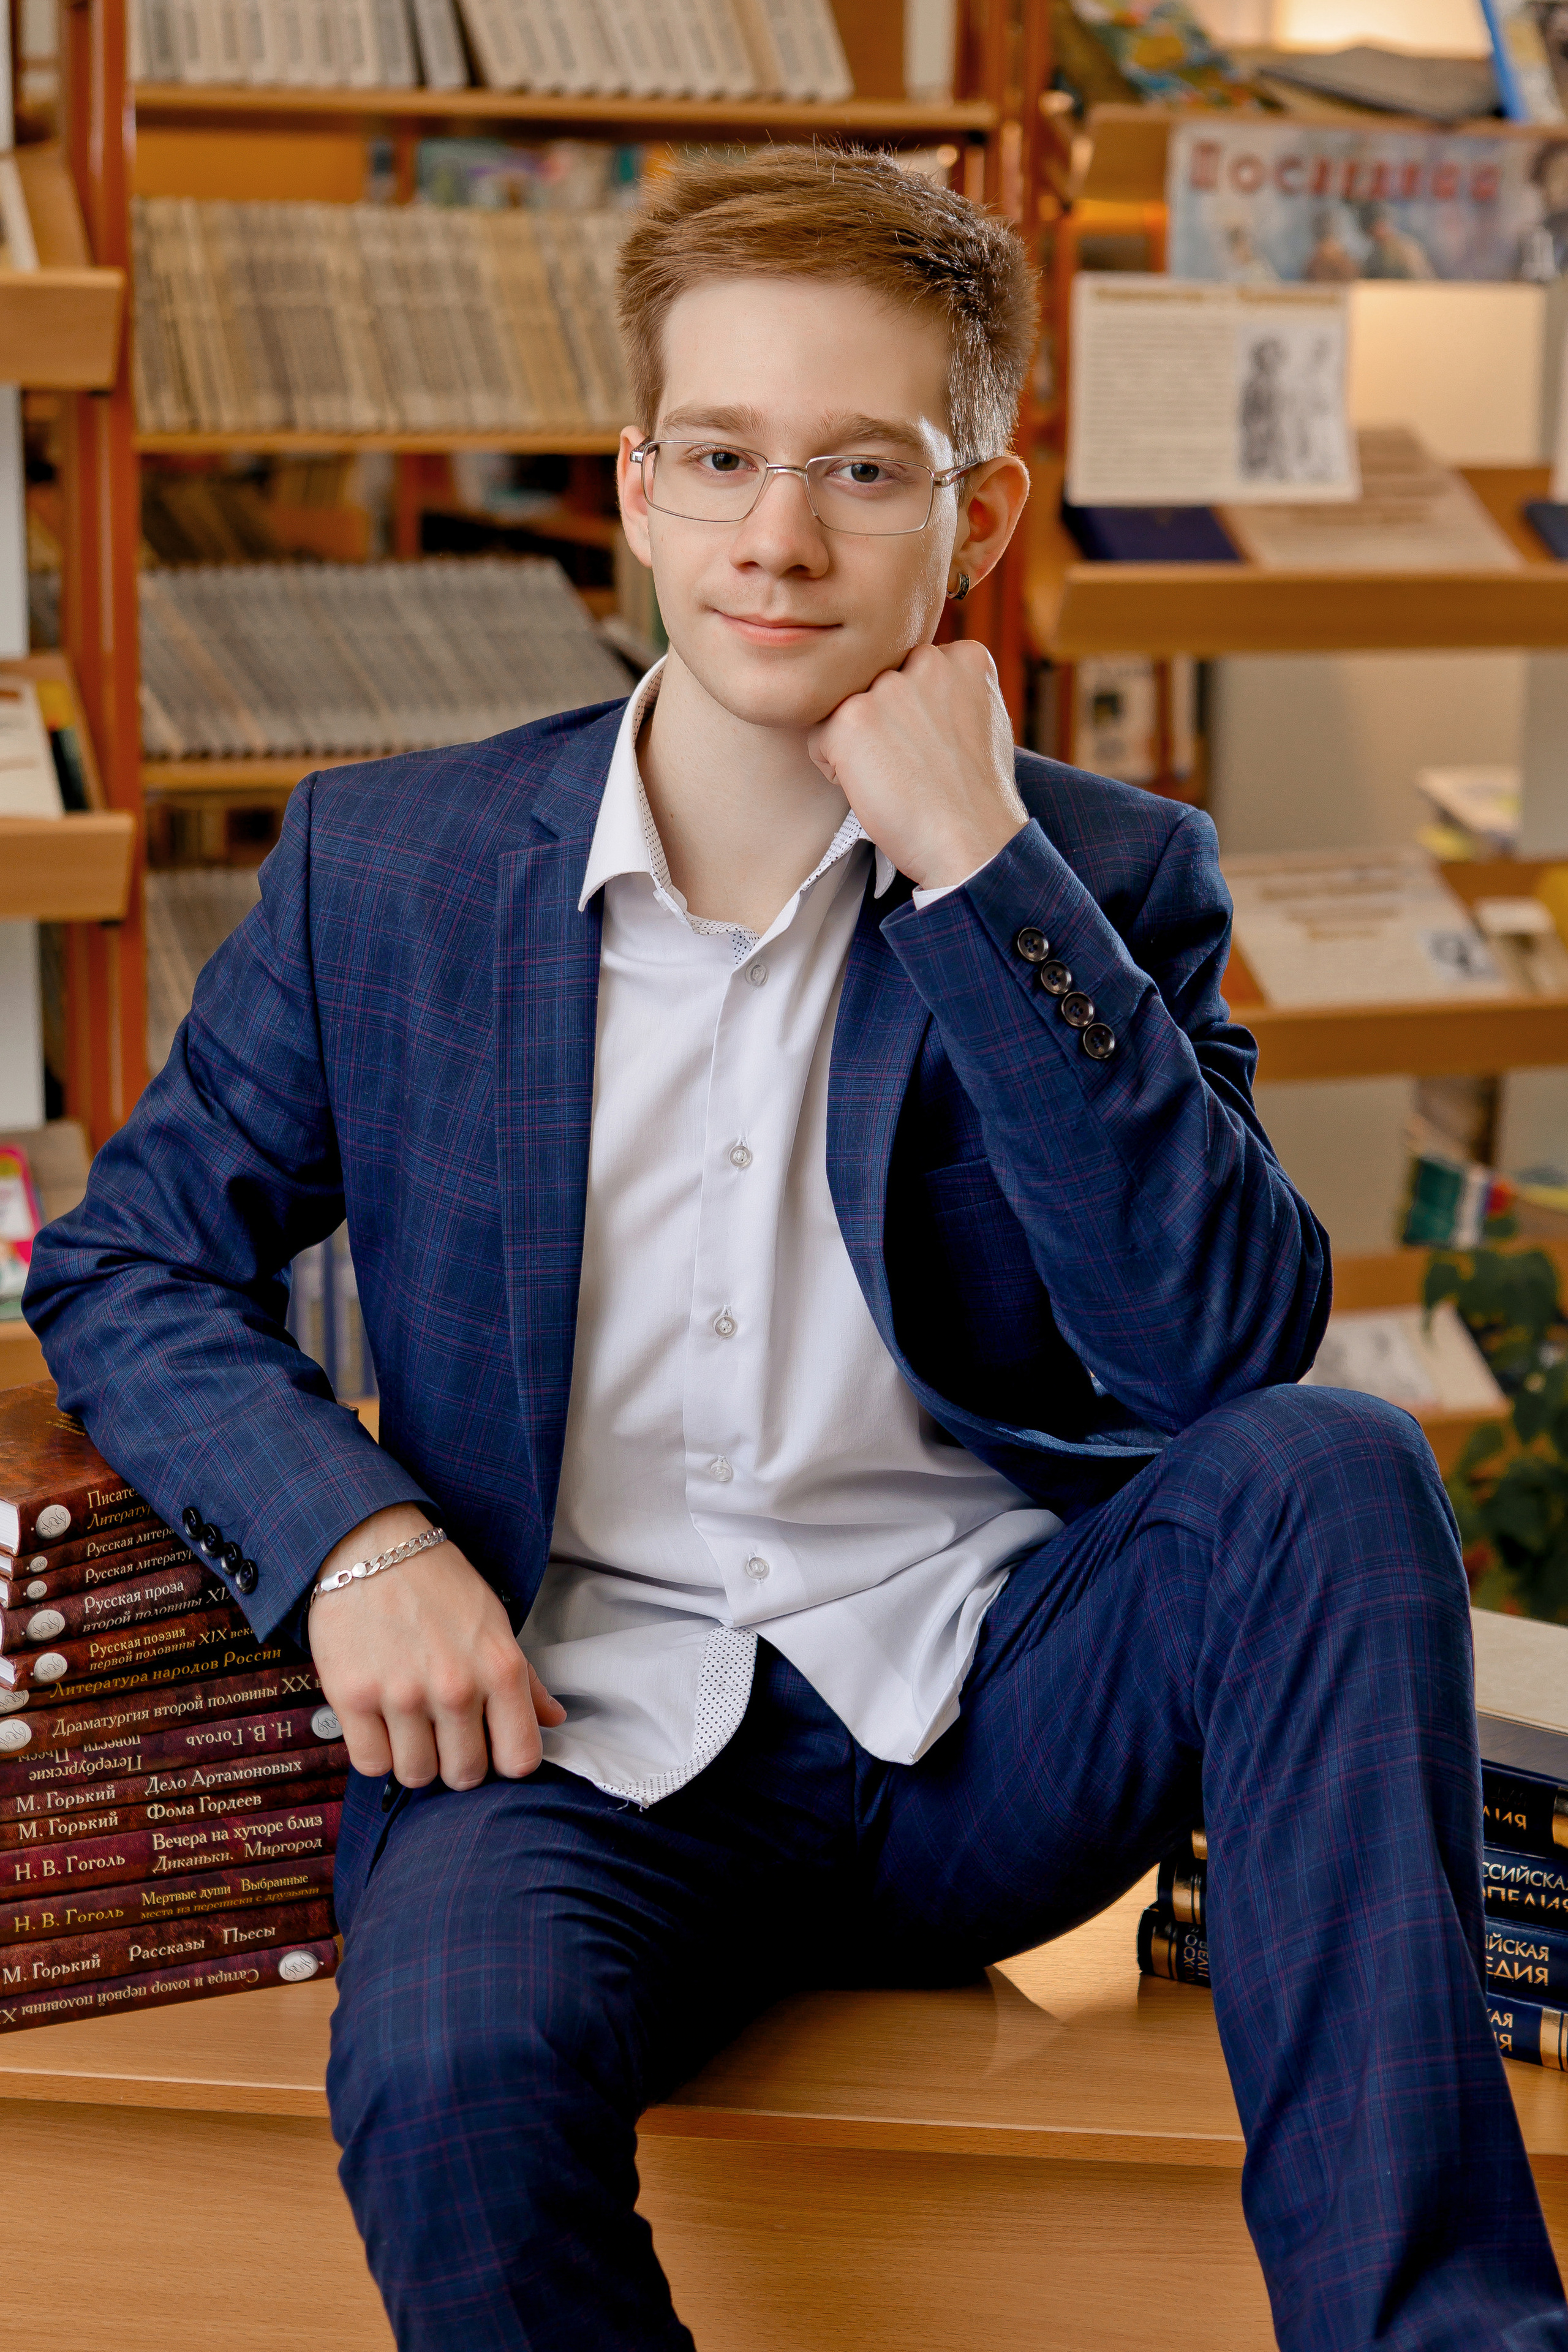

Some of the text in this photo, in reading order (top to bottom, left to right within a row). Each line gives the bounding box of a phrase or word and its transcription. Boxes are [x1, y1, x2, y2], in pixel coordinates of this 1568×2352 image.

[87, 1487, 138, 1509] Писате
[87, 1536, 134, 1557] Русская
[85, 1563, 134, 1584] Русская
[83, 1611, 130, 1632] второй
[135, 1597, 202, 1620] половины
[206, 1586, 232, 1604] XI
[84, 1581, 184, 1614] Русская проза
[89, 1627, 186, 1658] Русская поэзия
[89, 1651, 132, 1671] первой
[135, 1640, 195, 1660] половины
[198, 1628, 228, 1646] XIX
[50, 1649, 282, 1698] Литература народов России
[52, 1709, 149, 1739] Драматургия
[153, 1695, 203, 1717] второй
[208, 1686, 277, 1707] половины
[281, 1674, 312, 1695] XX
[84, 1735, 141, 1752] повести
[186, 1729, 243, 1747] Гоголь
[29, 1755, 142, 1781] Петербургские
[144, 1760, 302, 1796] Дело Артамоновых
[16, 1784, 116, 1813] М. Горький
[146, 1795, 262, 1820] Фома Гордеев
[18, 1811, 119, 1840] М. Горький
[152, 1815, 323, 1850] Вечера на хуторе близ
[14, 1855, 126, 1881] Н. В. Гоголь
[153, 1838, 322, 1874] Диканьки. Миргород
[141, 1875, 309, 1906] Мертвые души Выбранные
[1482, 1861, 1568, 1891] СИЙСКА
[140, 1909, 173, 1920] места
[176, 1905, 190, 1915] из
[194, 1897, 253, 1912] переписки
[265, 1887, 319, 1901] друзьями
[13, 1909, 124, 1932] Н. В. Гоголь
[129, 1926, 276, 1962] Рассказы Пьесы
[2, 1953, 101, 1985] М. Горький
[194, 1977, 203, 1987] и
[207, 1968, 260, 1984] Сатира
[97, 1985, 147, 2007] первой
[151, 1980, 190, 1994] юмор
[21, 1995, 93, 2016] половины
[1487, 2008, 1513, 2028] АЯ
